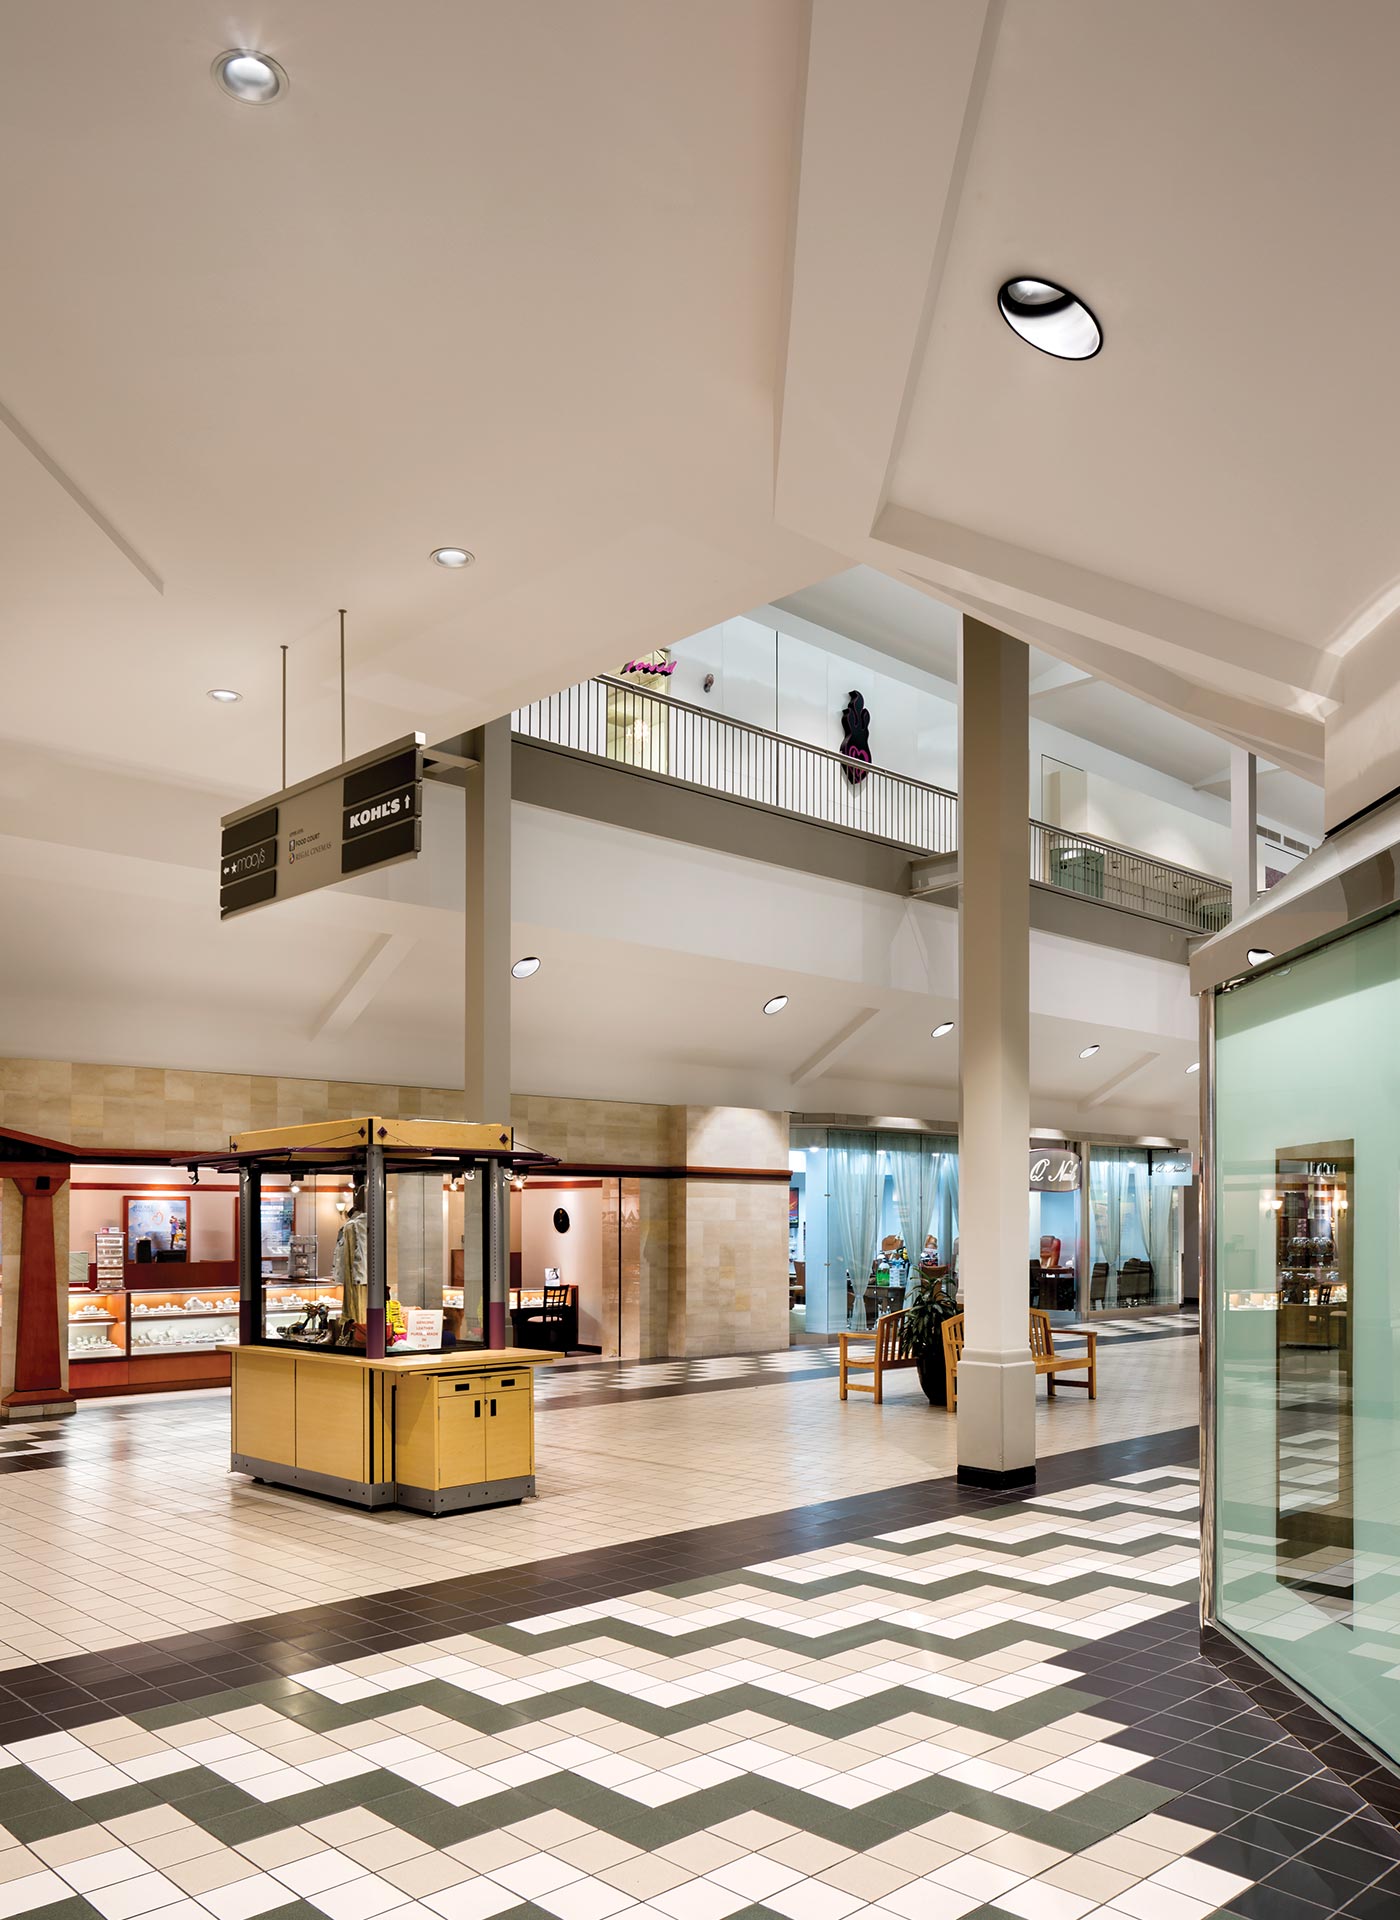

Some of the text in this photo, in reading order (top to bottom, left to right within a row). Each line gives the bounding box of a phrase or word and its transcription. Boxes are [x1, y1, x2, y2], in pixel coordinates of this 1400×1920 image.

[349, 798, 401, 829] KOHL'S
[307, 832, 320, 843] COURT
[1029, 1158, 1051, 1182] Q
